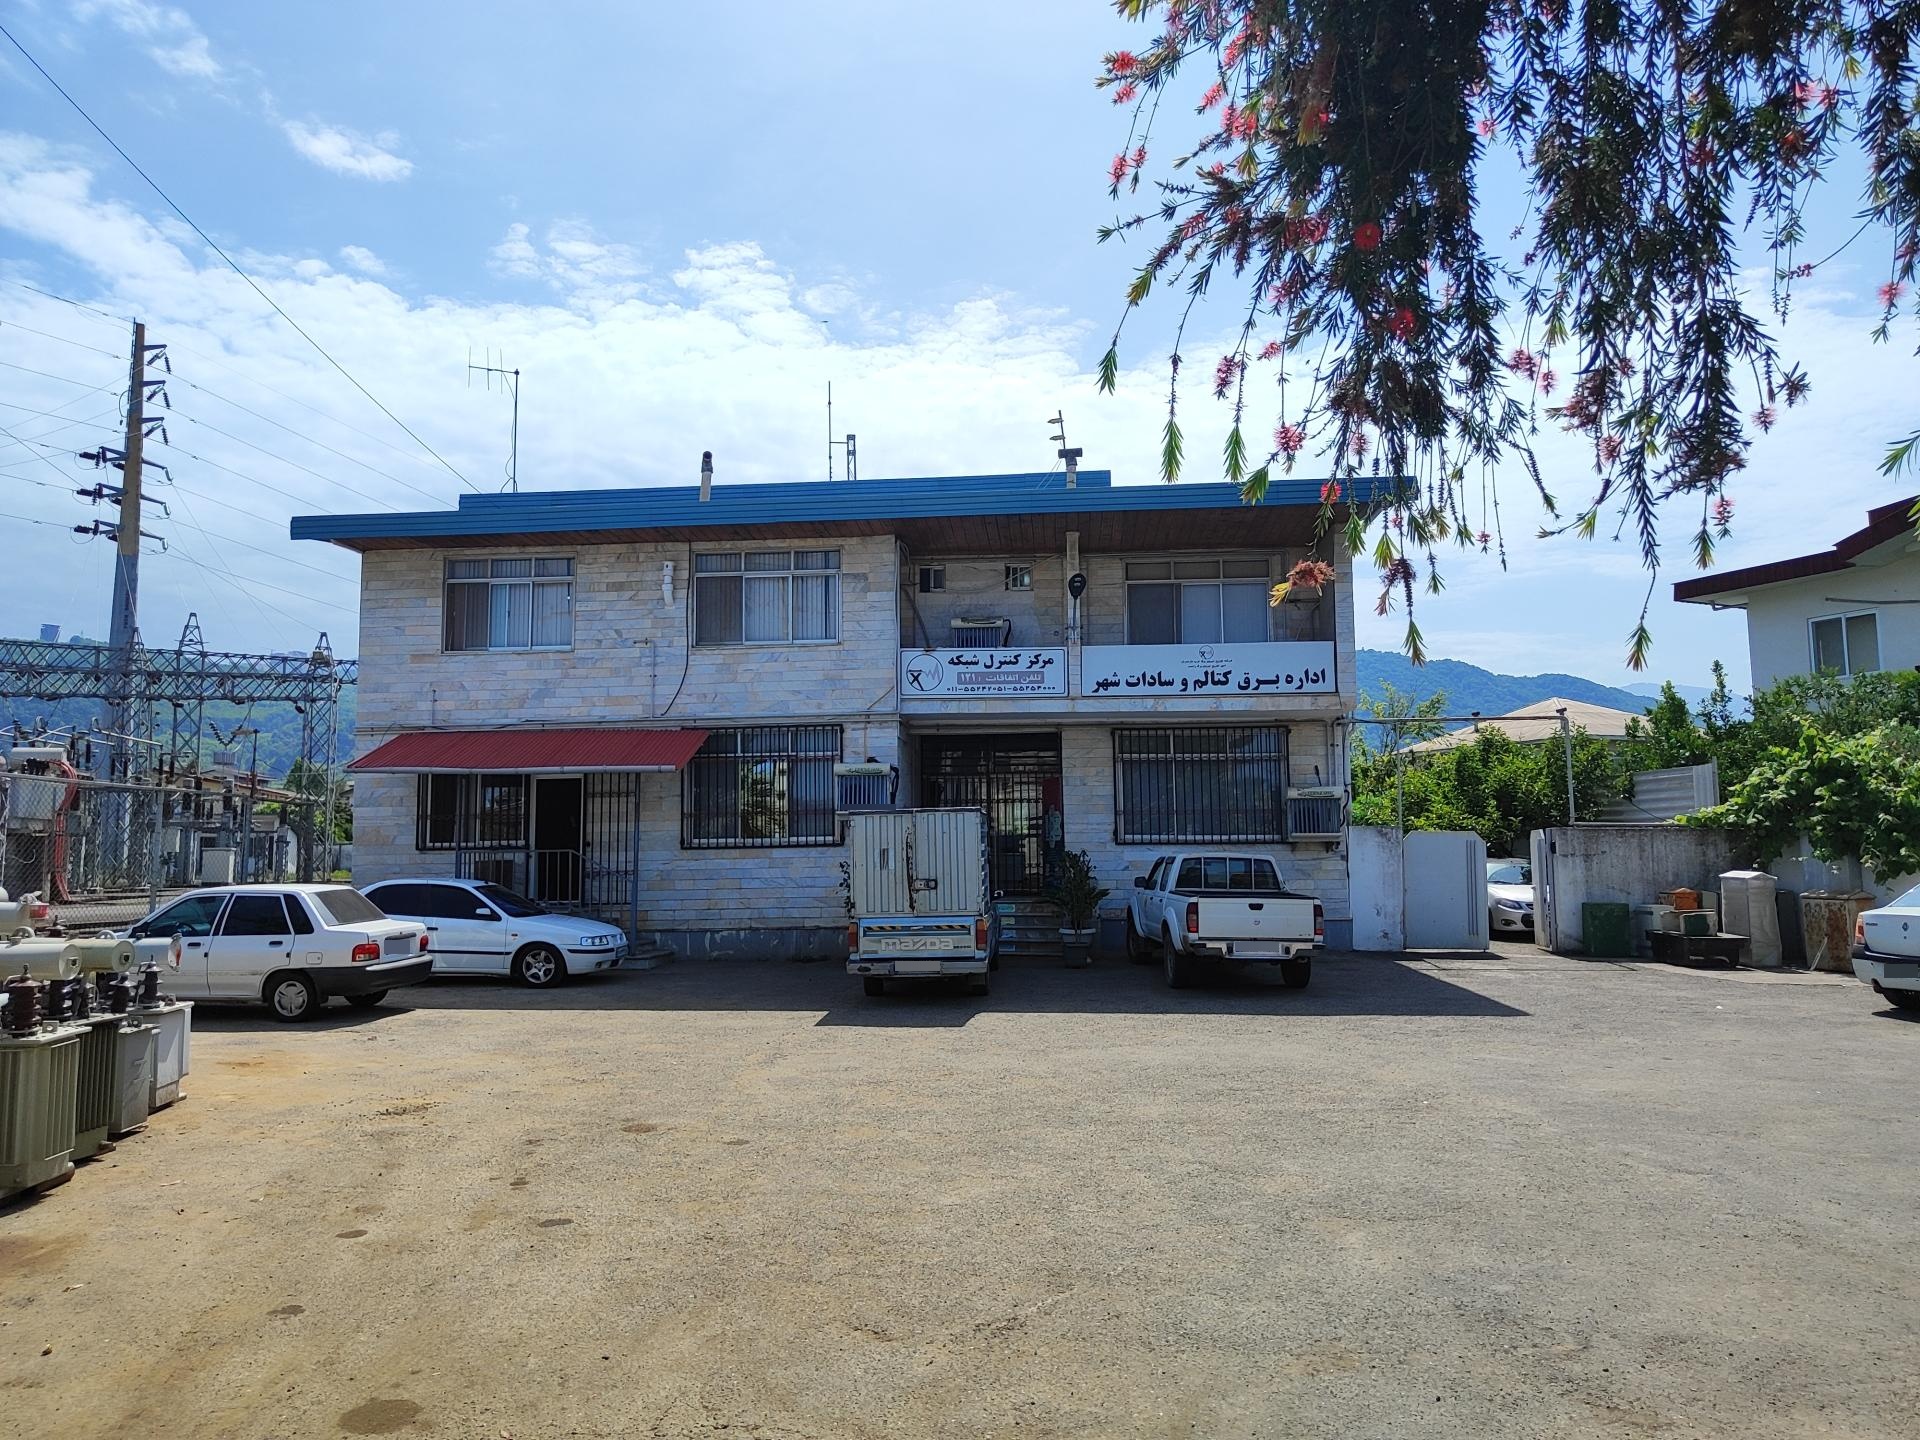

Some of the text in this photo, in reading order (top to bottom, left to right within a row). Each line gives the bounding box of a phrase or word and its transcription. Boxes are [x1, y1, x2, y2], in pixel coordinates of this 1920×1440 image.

[947, 653, 1055, 669] مرکز کنترل شبکه
[960, 672, 976, 682] ۱۲۱
[985, 672, 1019, 682] اتفاقات
[1020, 673, 1041, 683] تلفن
[1091, 667, 1326, 694] اداره برق کتالم و سادات شهر
